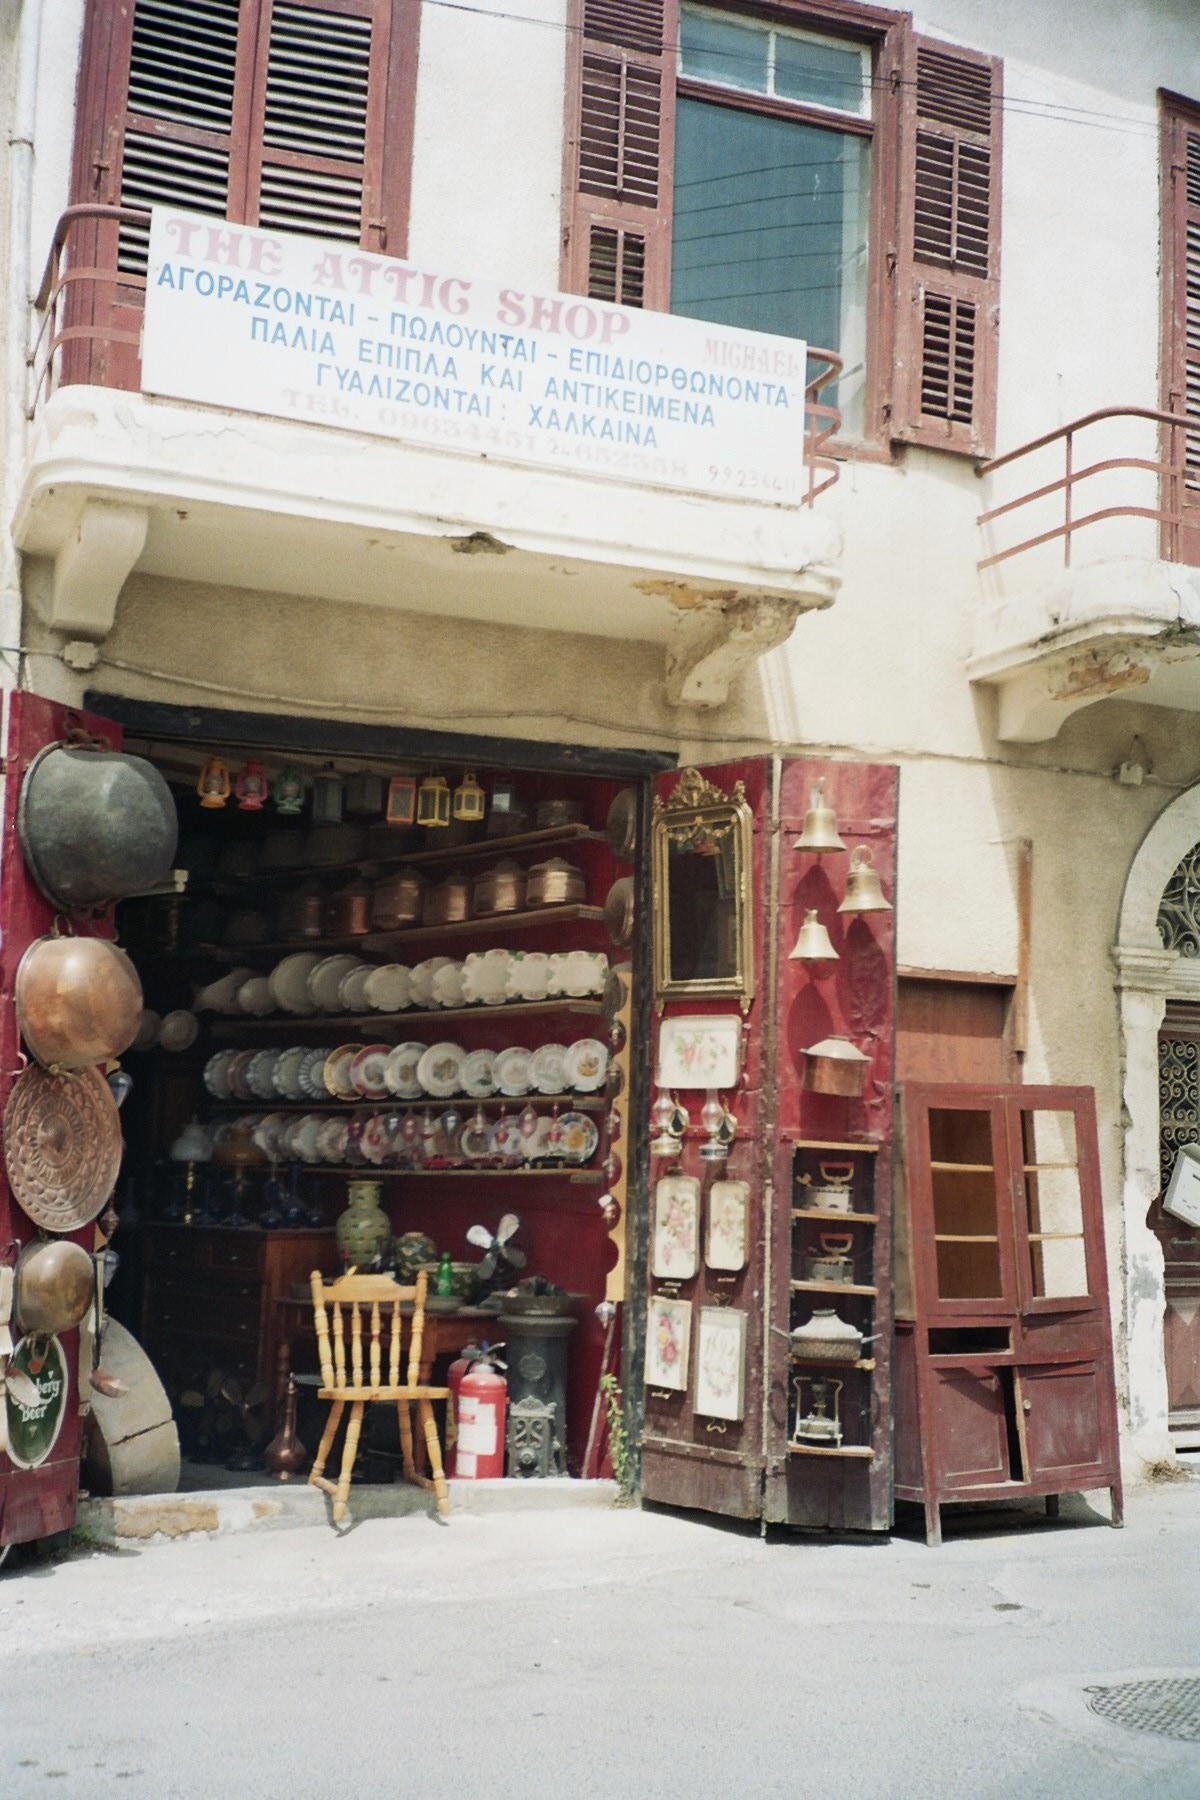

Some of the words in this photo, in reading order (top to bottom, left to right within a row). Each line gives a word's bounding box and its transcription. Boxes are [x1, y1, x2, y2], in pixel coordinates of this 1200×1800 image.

[157, 263, 355, 326] ΑΓΟΡΑΖΟΝΤΑΙ
[389, 312, 537, 363] ΠΩΛΟΥΝΤΑΙ
[165, 218, 283, 277] THE
[312, 250, 472, 316] ATTIC
[497, 289, 631, 344] SHOP
[250, 317, 336, 356] ΠΑΛΙΑ
[358, 339, 458, 380] ΕΠΙΠΛΑ
[480, 364, 523, 393] ΚΑΙ
[544, 376, 716, 427] ΑΝΤΙΚΕΙΜΕΝΑ
[704, 338, 799, 379] MICHAEL
[529, 404, 658, 449] ΧΑΛΚΑΙΝΑ
[18, 1404, 48, 1423] Beer
